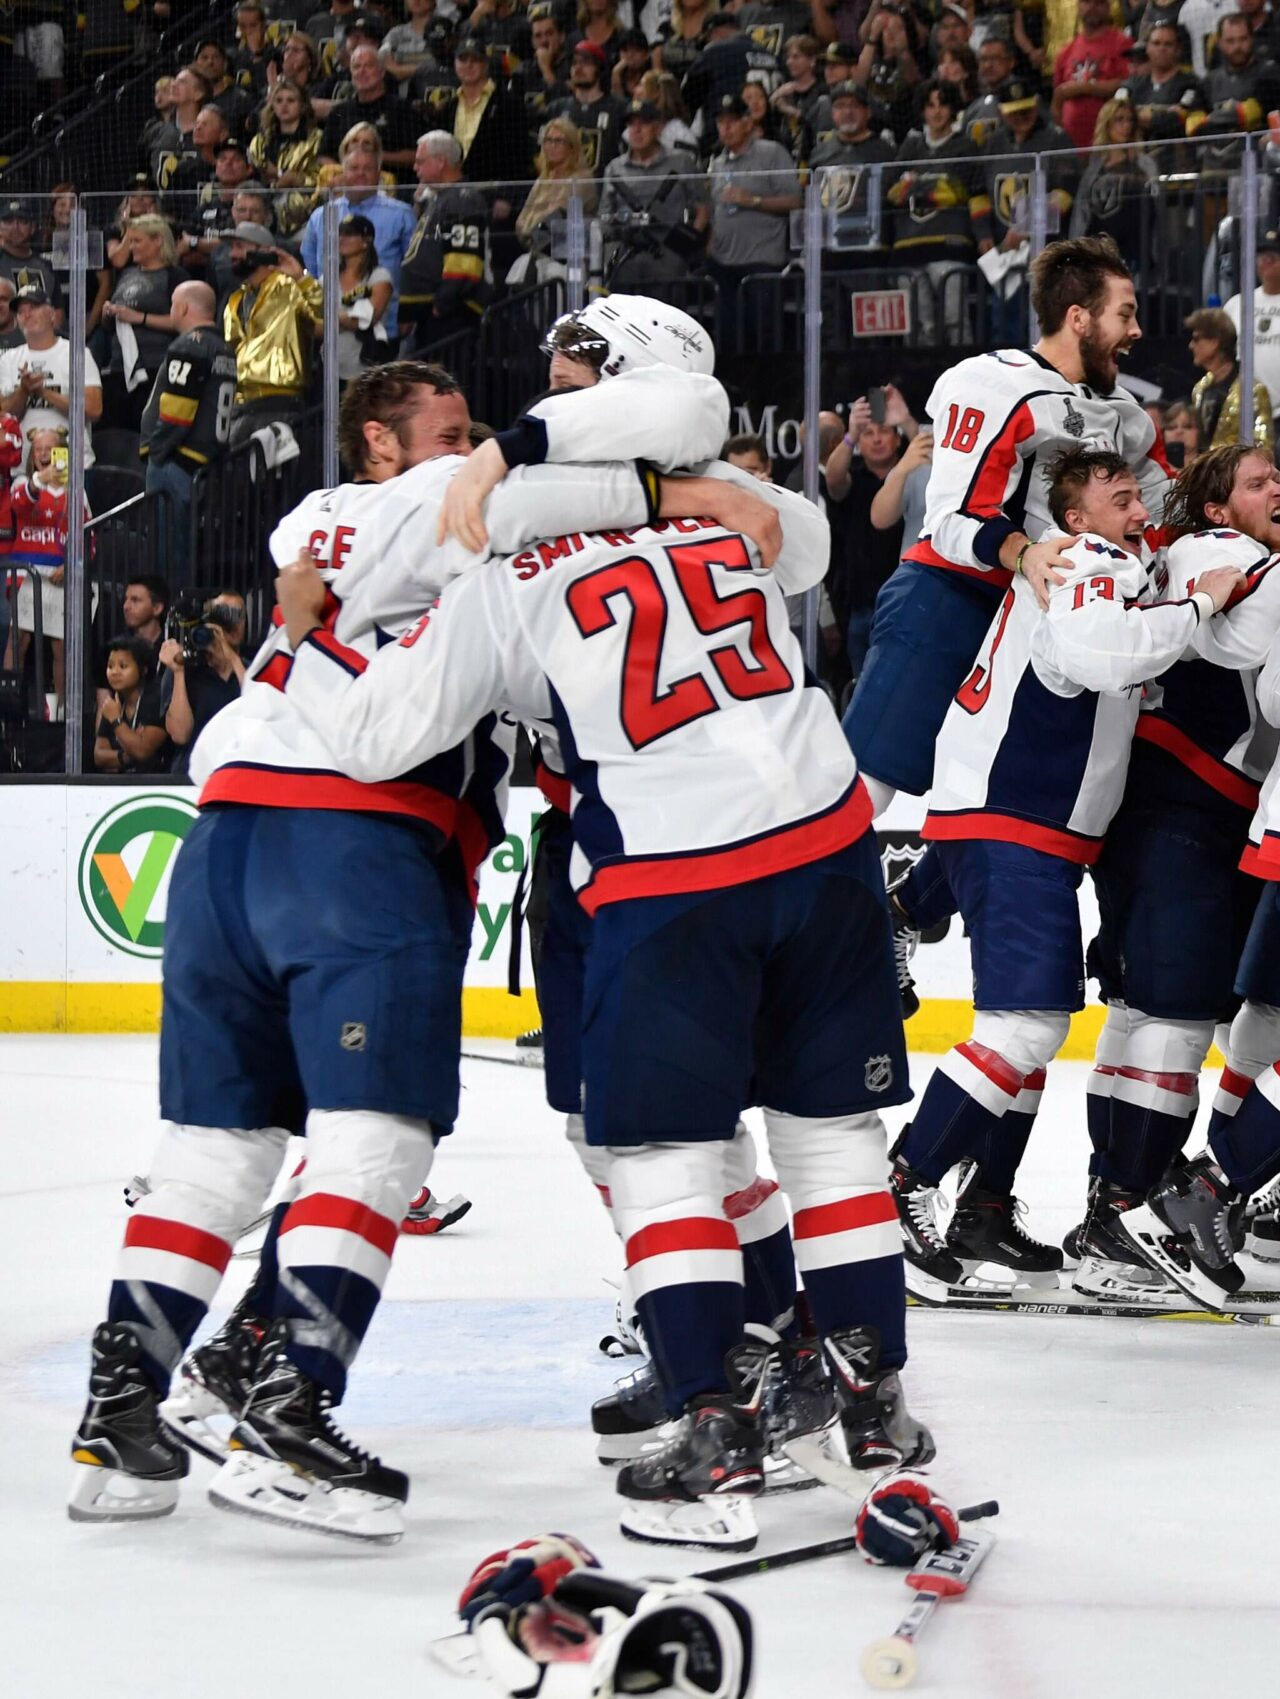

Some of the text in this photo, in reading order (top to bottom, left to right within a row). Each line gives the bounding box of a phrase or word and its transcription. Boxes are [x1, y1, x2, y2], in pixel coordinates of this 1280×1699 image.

[168, 359, 192, 387] 81
[940, 403, 985, 454] 18
[1071, 575, 1116, 611] 13
[564, 533, 795, 753] 25
